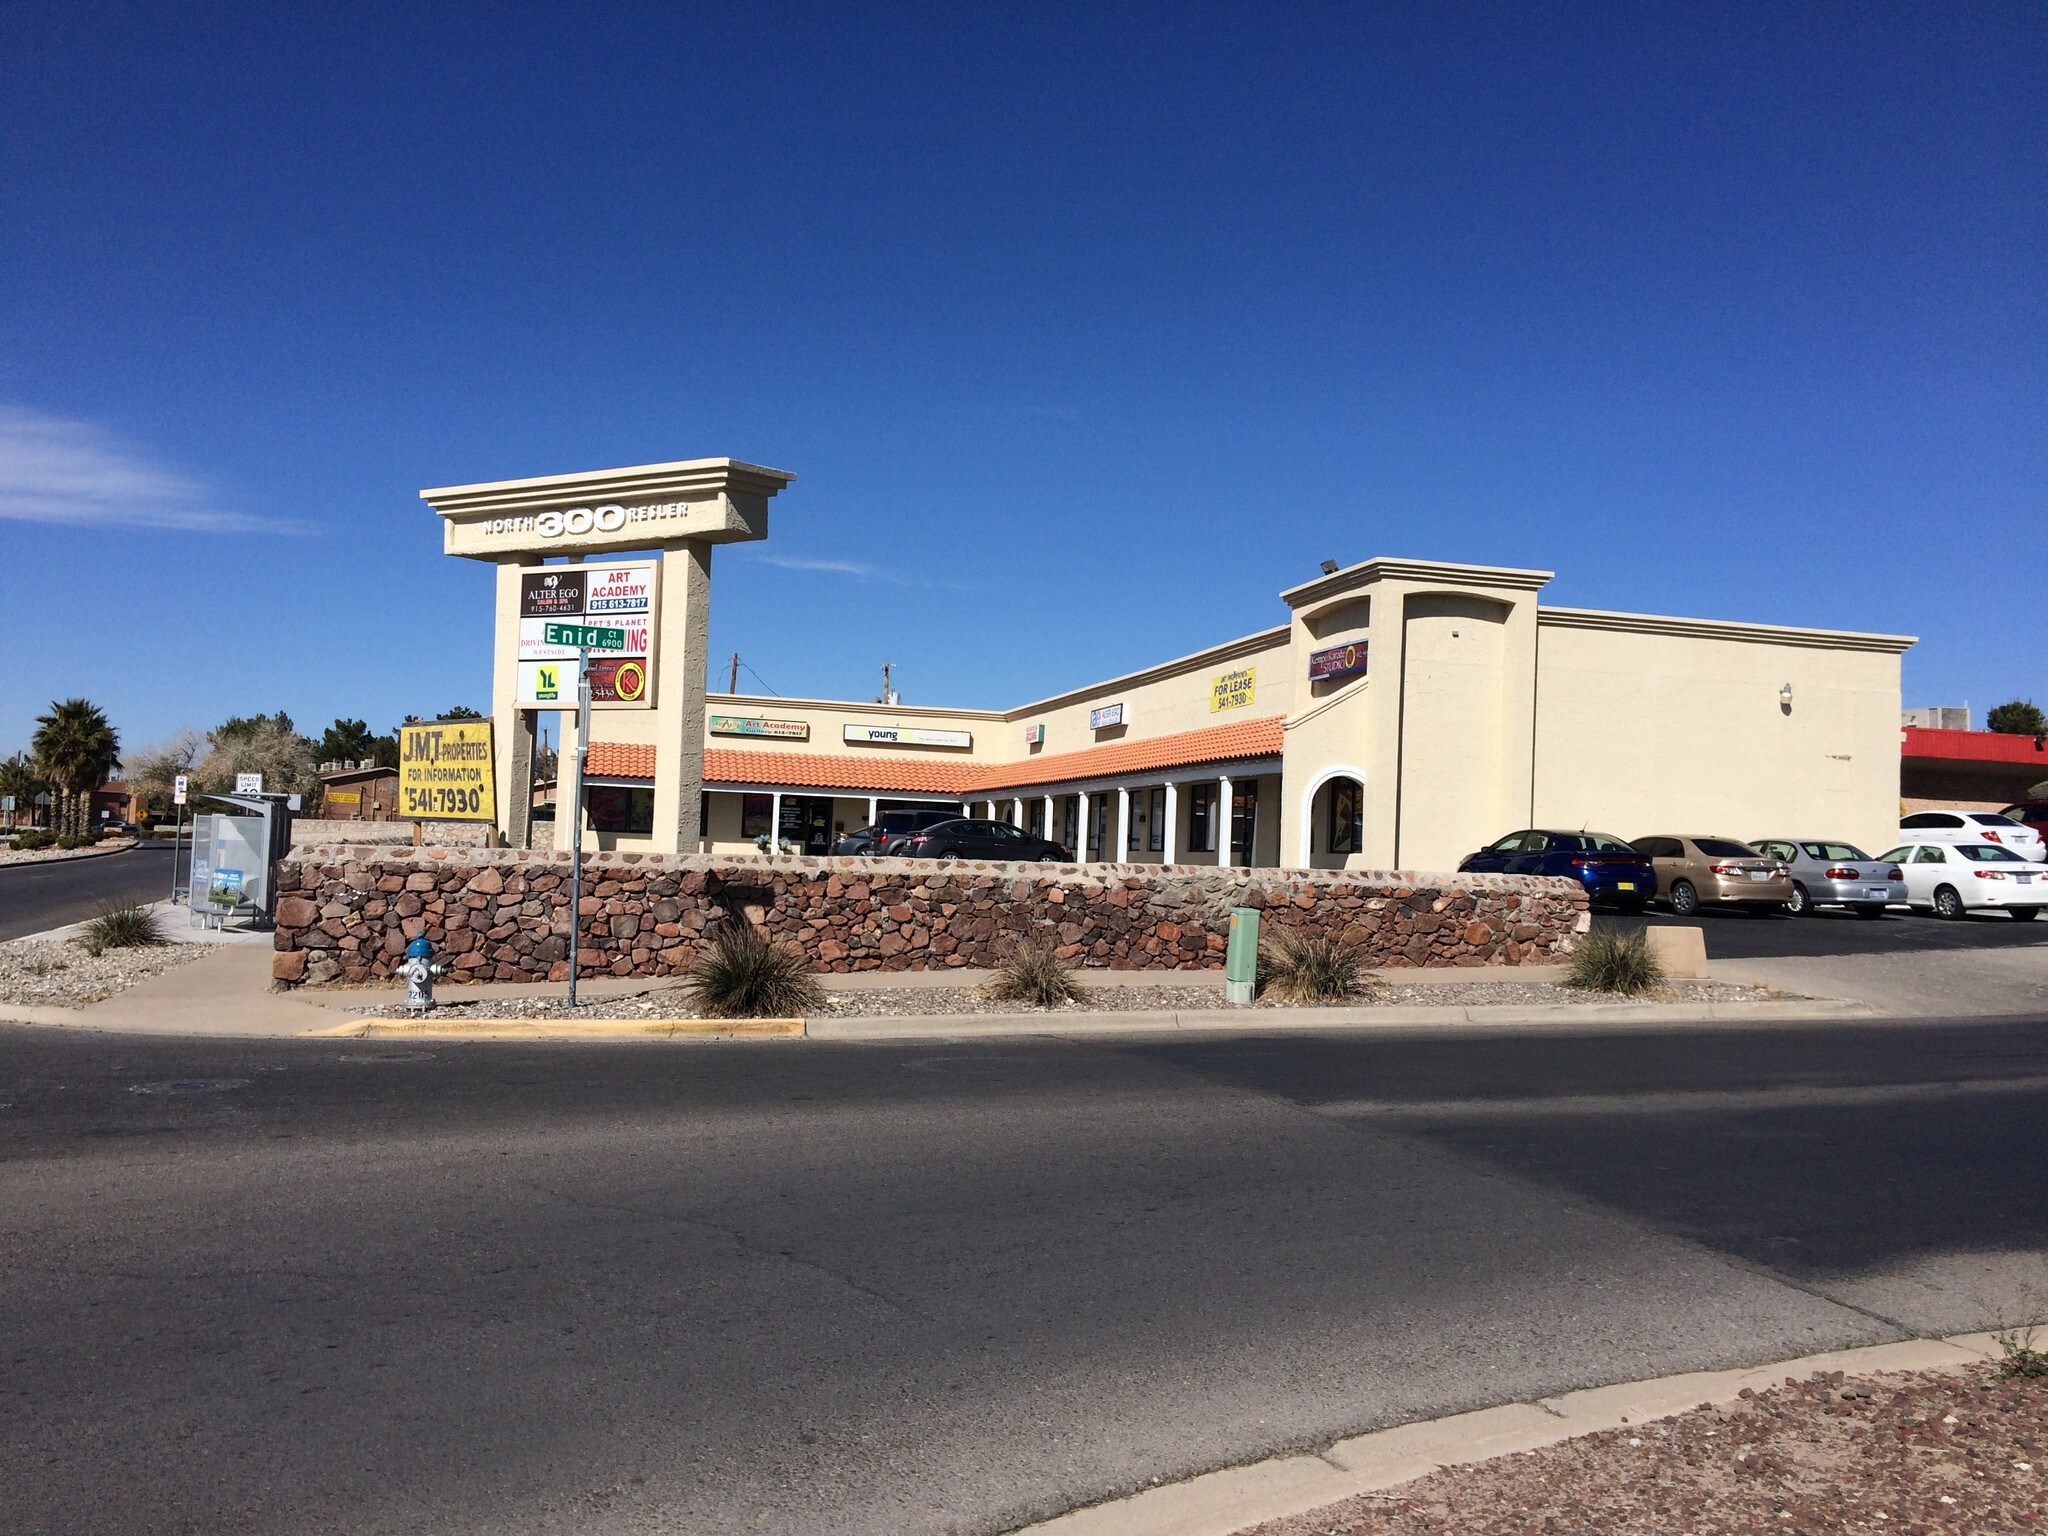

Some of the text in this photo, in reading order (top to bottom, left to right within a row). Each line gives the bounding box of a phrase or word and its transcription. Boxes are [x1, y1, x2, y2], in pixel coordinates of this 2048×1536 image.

[483, 502, 689, 538] NORTH 300 RESLER
[608, 571, 631, 584] ART
[528, 588, 579, 600] ALTER EGO
[591, 584, 647, 598] ACADEMY
[530, 604, 575, 613] 915-760-4631
[591, 598, 647, 609] 915 613-7817
[615, 618, 648, 626] PLANET
[546, 625, 598, 646] Enid
[608, 630, 617, 639] Ct
[520, 639, 547, 647] DRIVIN
[601, 638, 623, 648] 6900
[1214, 677, 1253, 697] FOR LEASE
[1218, 692, 1247, 709] 541-7930
[745, 720, 761, 728] Art
[762, 721, 806, 731] Academy
[868, 729, 898, 741] young
[404, 730, 488, 762] JMT PROPERTIES
[408, 767, 482, 781] FOR INFORMATION
[408, 787, 480, 813] 541-7930
